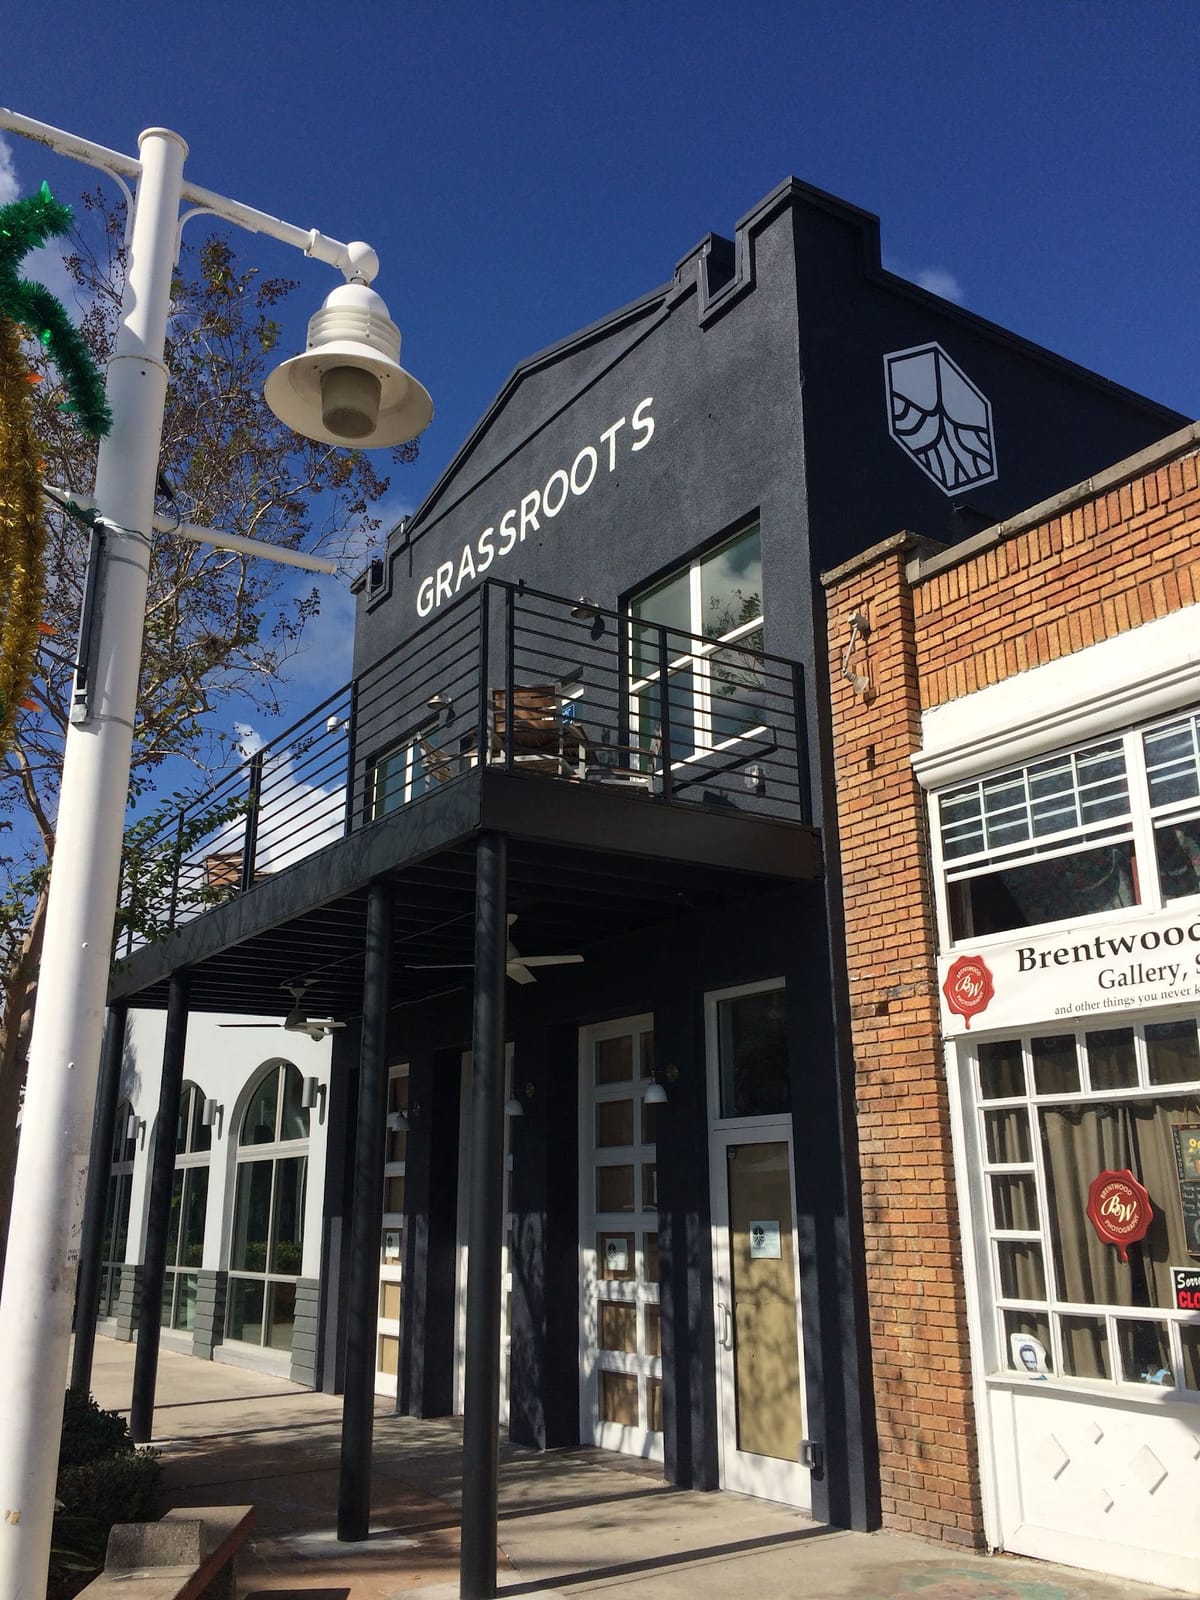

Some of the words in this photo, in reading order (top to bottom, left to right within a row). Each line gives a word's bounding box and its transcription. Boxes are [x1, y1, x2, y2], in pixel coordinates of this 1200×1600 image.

[416, 397, 655, 617] GRASSROOTS
[1098, 963, 1187, 989] Gallery,
[1054, 1003, 1072, 1015] and
[1075, 1000, 1100, 1012] other
[1103, 997, 1136, 1008] things
[1138, 993, 1157, 1006] you
[1161, 988, 1191, 999] never
[1100, 1183, 1133, 1199] BRENTWOOD
[1104, 1214, 1140, 1234] PHOTOGRAPHY
